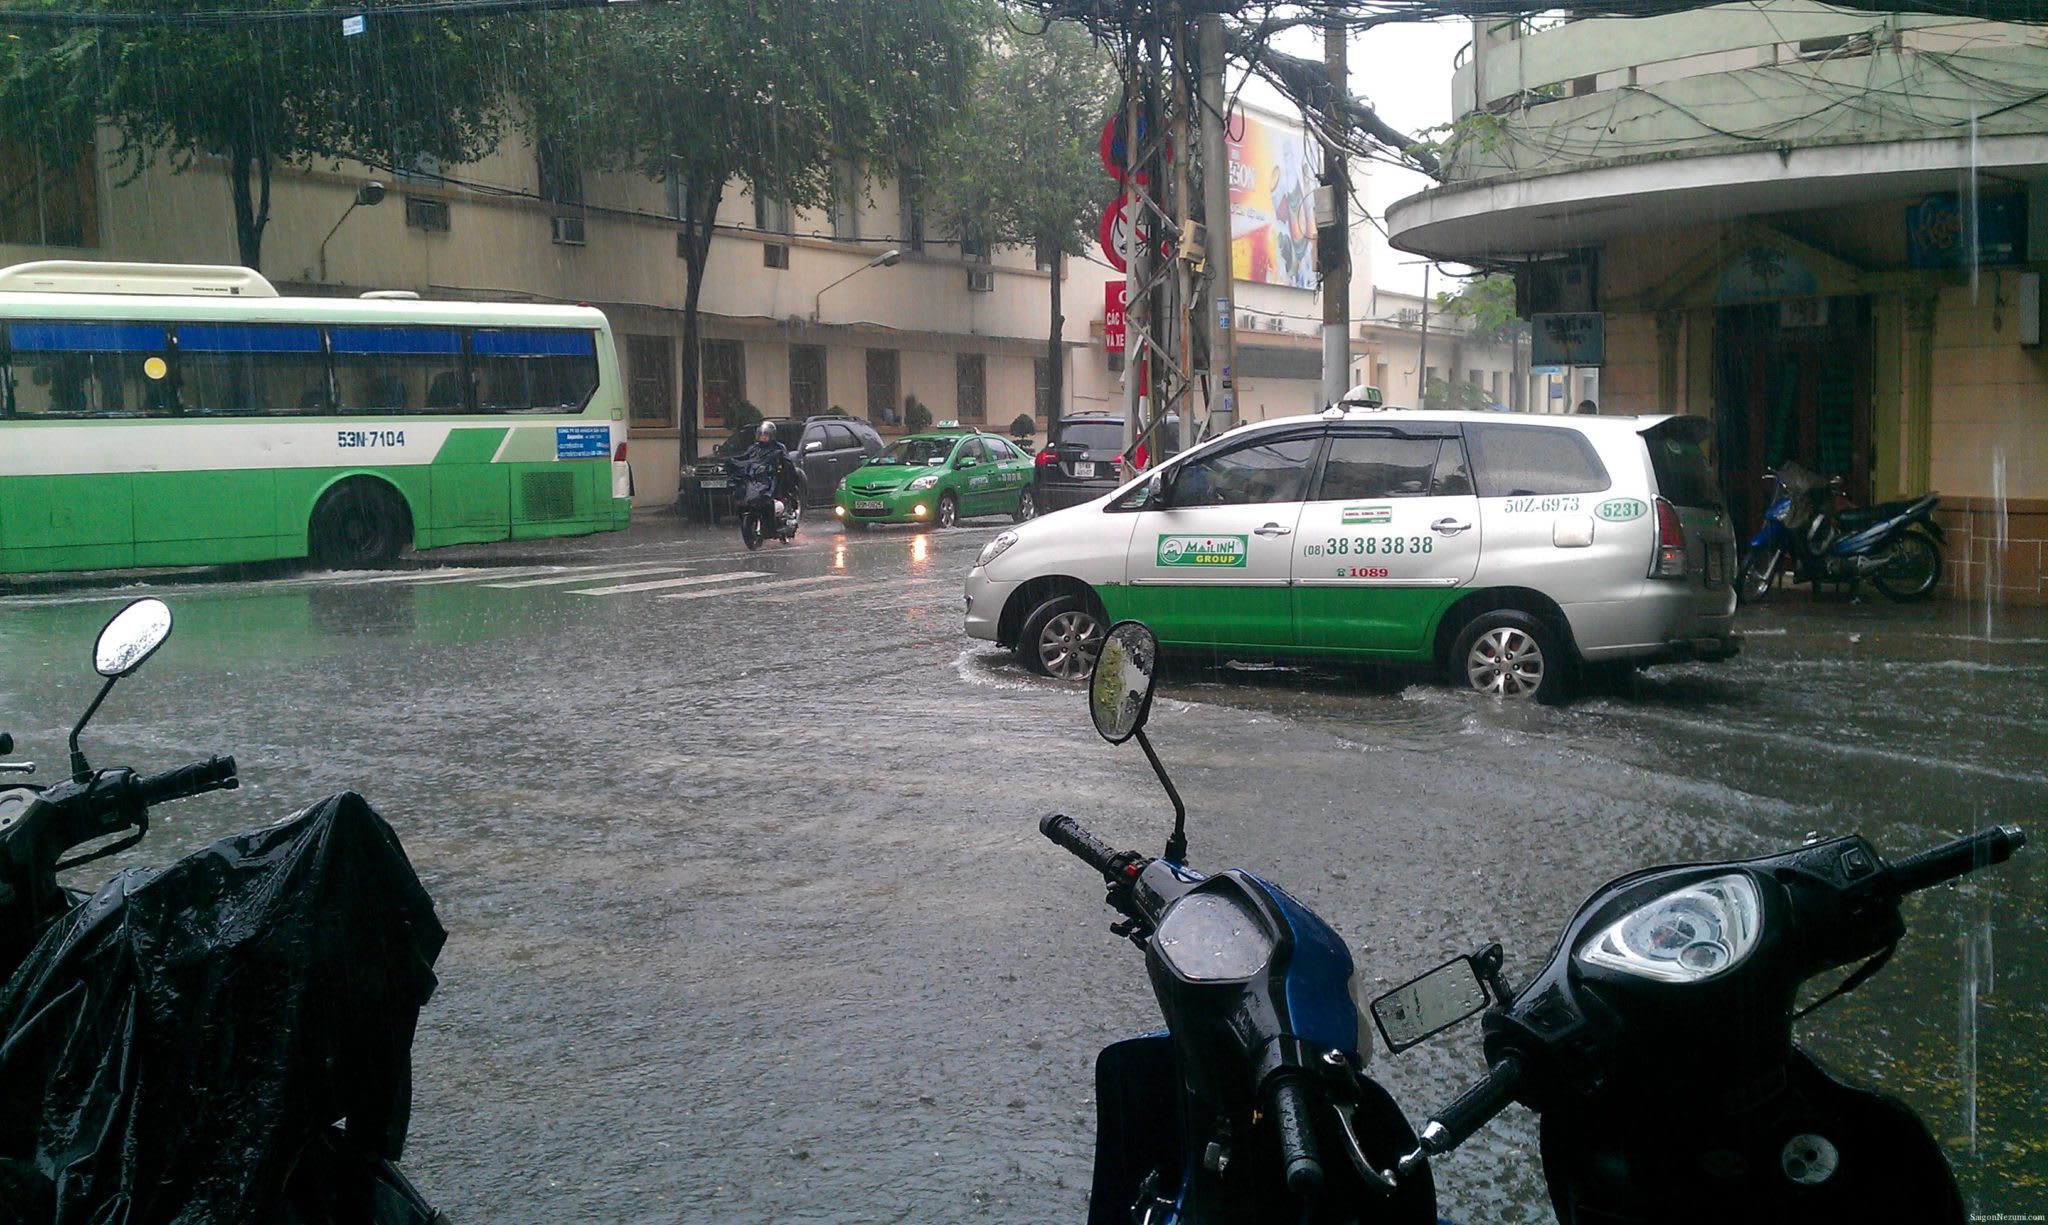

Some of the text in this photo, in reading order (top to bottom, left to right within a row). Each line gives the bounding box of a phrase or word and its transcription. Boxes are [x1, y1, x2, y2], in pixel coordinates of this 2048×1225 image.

[1116, 333, 1125, 347] XE
[337, 430, 405, 448] 53N-7104
[1504, 497, 1580, 513] 50Z-6973
[1603, 502, 1640, 518] 5231
[1326, 537, 1349, 556] 38
[1354, 537, 1377, 555] 38
[1381, 537, 1405, 555] 38
[1409, 536, 1433, 554] 38
[1196, 555, 1235, 563] GROUP
[1350, 568, 1389, 578] 1089
